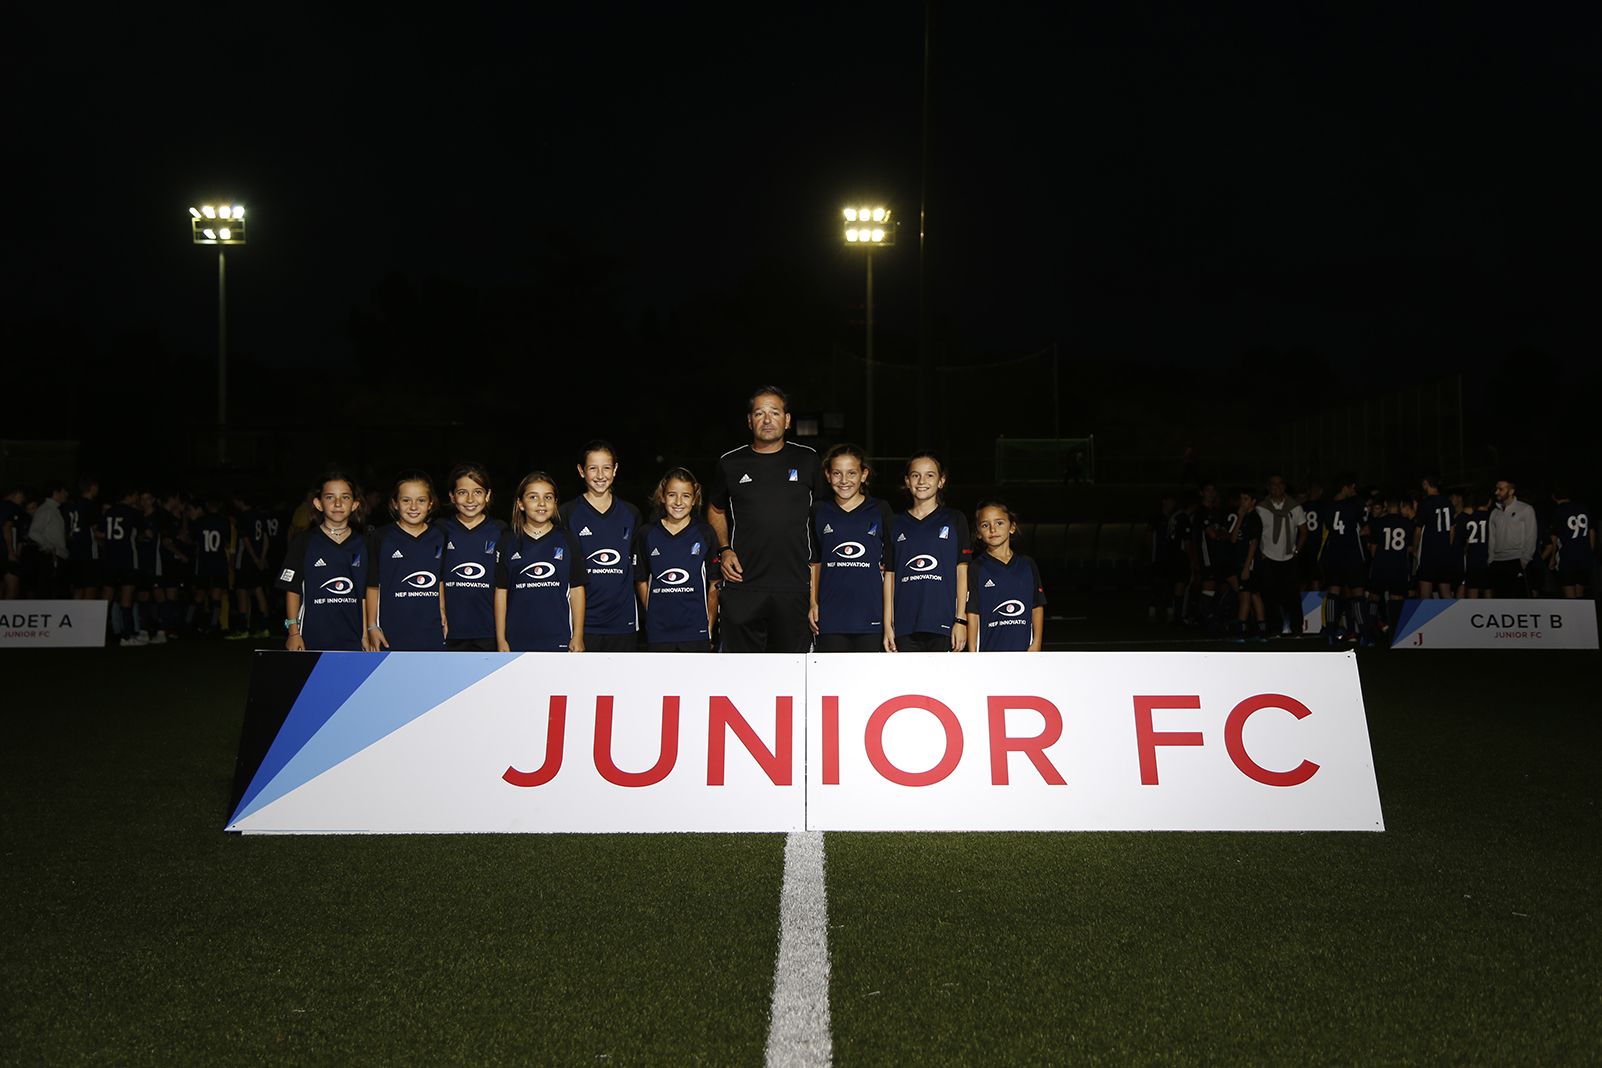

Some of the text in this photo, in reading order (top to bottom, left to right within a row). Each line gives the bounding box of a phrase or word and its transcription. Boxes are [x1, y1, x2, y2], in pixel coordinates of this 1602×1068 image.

[1305, 510, 1319, 532] 8
[1332, 510, 1346, 535] 4
[1434, 506, 1451, 532] 11
[1566, 513, 1589, 539] 99
[106, 516, 125, 540] 15
[1465, 519, 1487, 544] 21
[202, 529, 221, 553] 10
[1382, 526, 1406, 551] 18
[836, 561, 871, 569] INNOVATION
[455, 581, 490, 589] INNOVATION
[526, 580, 560, 588] INNOVATION
[909, 573, 943, 582] INNOVATION
[660, 586, 695, 594] INNOVATION
[0, 614, 73, 628] ADET A
[999, 618, 1027, 627] INNOVATIO
[1470, 614, 1563, 629] CADET B
[3, 631, 51, 639] JUNIOR FC
[1494, 631, 1542, 639] JUNIOR FC
[504, 693, 1320, 787] JUNIOR FC
